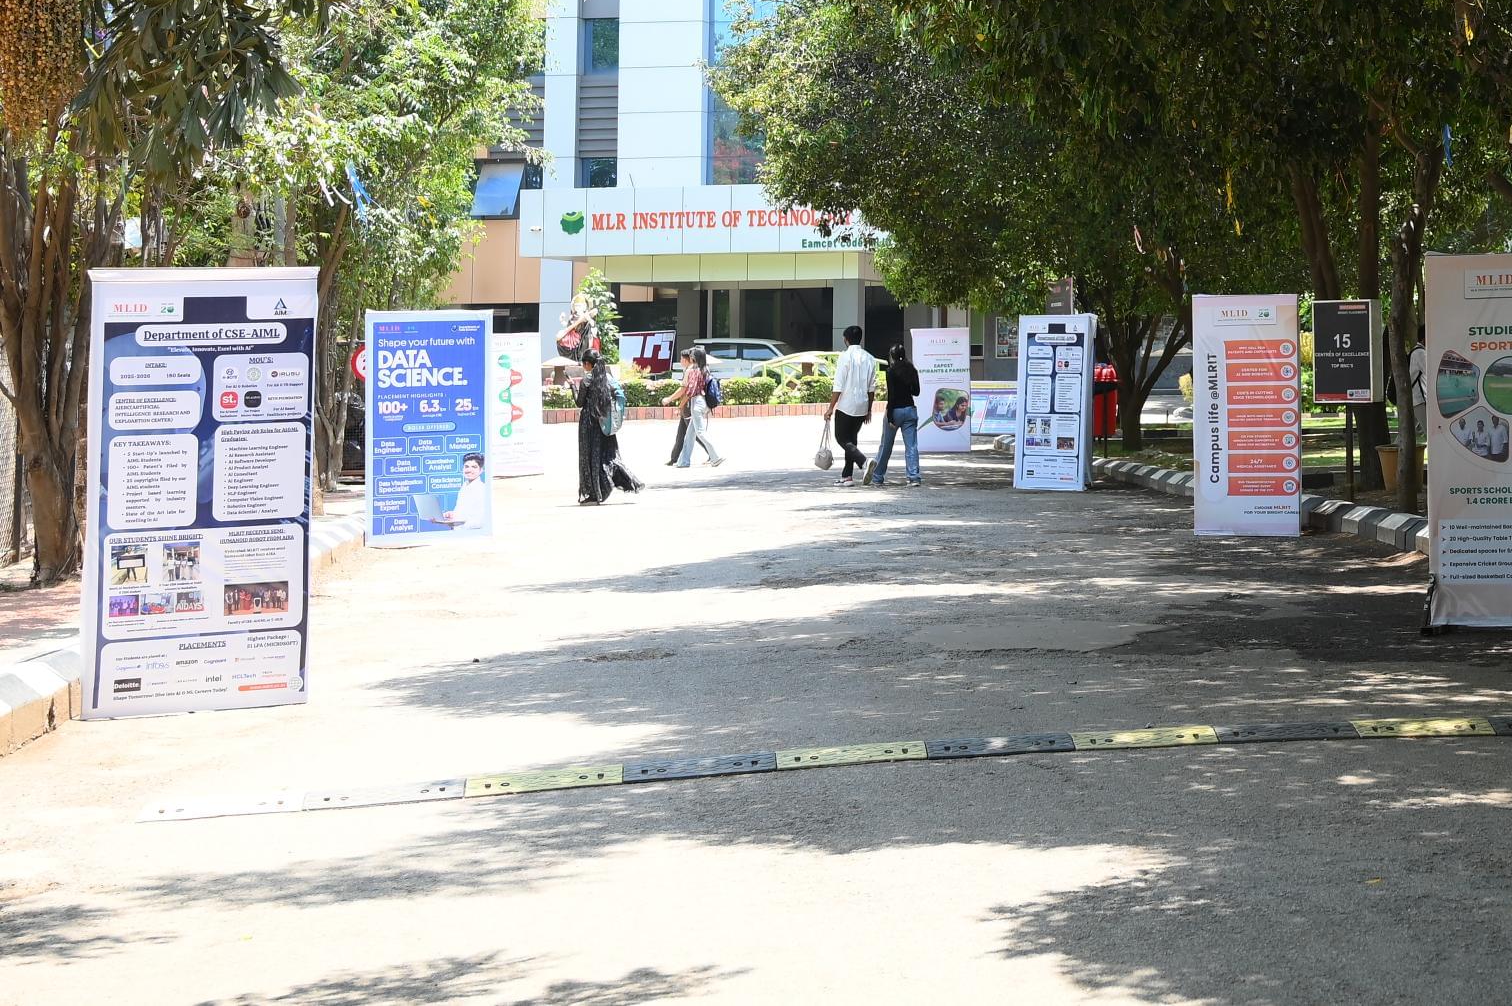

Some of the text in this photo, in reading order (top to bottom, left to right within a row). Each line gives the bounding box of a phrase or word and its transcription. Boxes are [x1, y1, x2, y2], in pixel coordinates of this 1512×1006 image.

[592, 213, 626, 231] MLR
[632, 211, 716, 230] INSTITUTE
[722, 209, 741, 228] OF
[802, 239, 837, 248] Eamcet
[144, 329, 280, 341] Department of CSE-AIML
[1334, 334, 1351, 348] 15
[378, 339, 406, 348] Shape
[430, 338, 454, 346] future
[456, 337, 475, 345] with
[378, 349, 432, 368] DATA
[378, 367, 468, 388] SCIENCE.
[378, 401, 408, 414] 100+
[420, 399, 440, 413] 6.3
[455, 399, 471, 411] 25
[1207, 353, 1223, 483] Campus life @MLRIT
[1450, 487, 1482, 495] SPORTS
[1467, 497, 1478, 505] 1.4
[179, 641, 226, 650] PLACEMENTS
